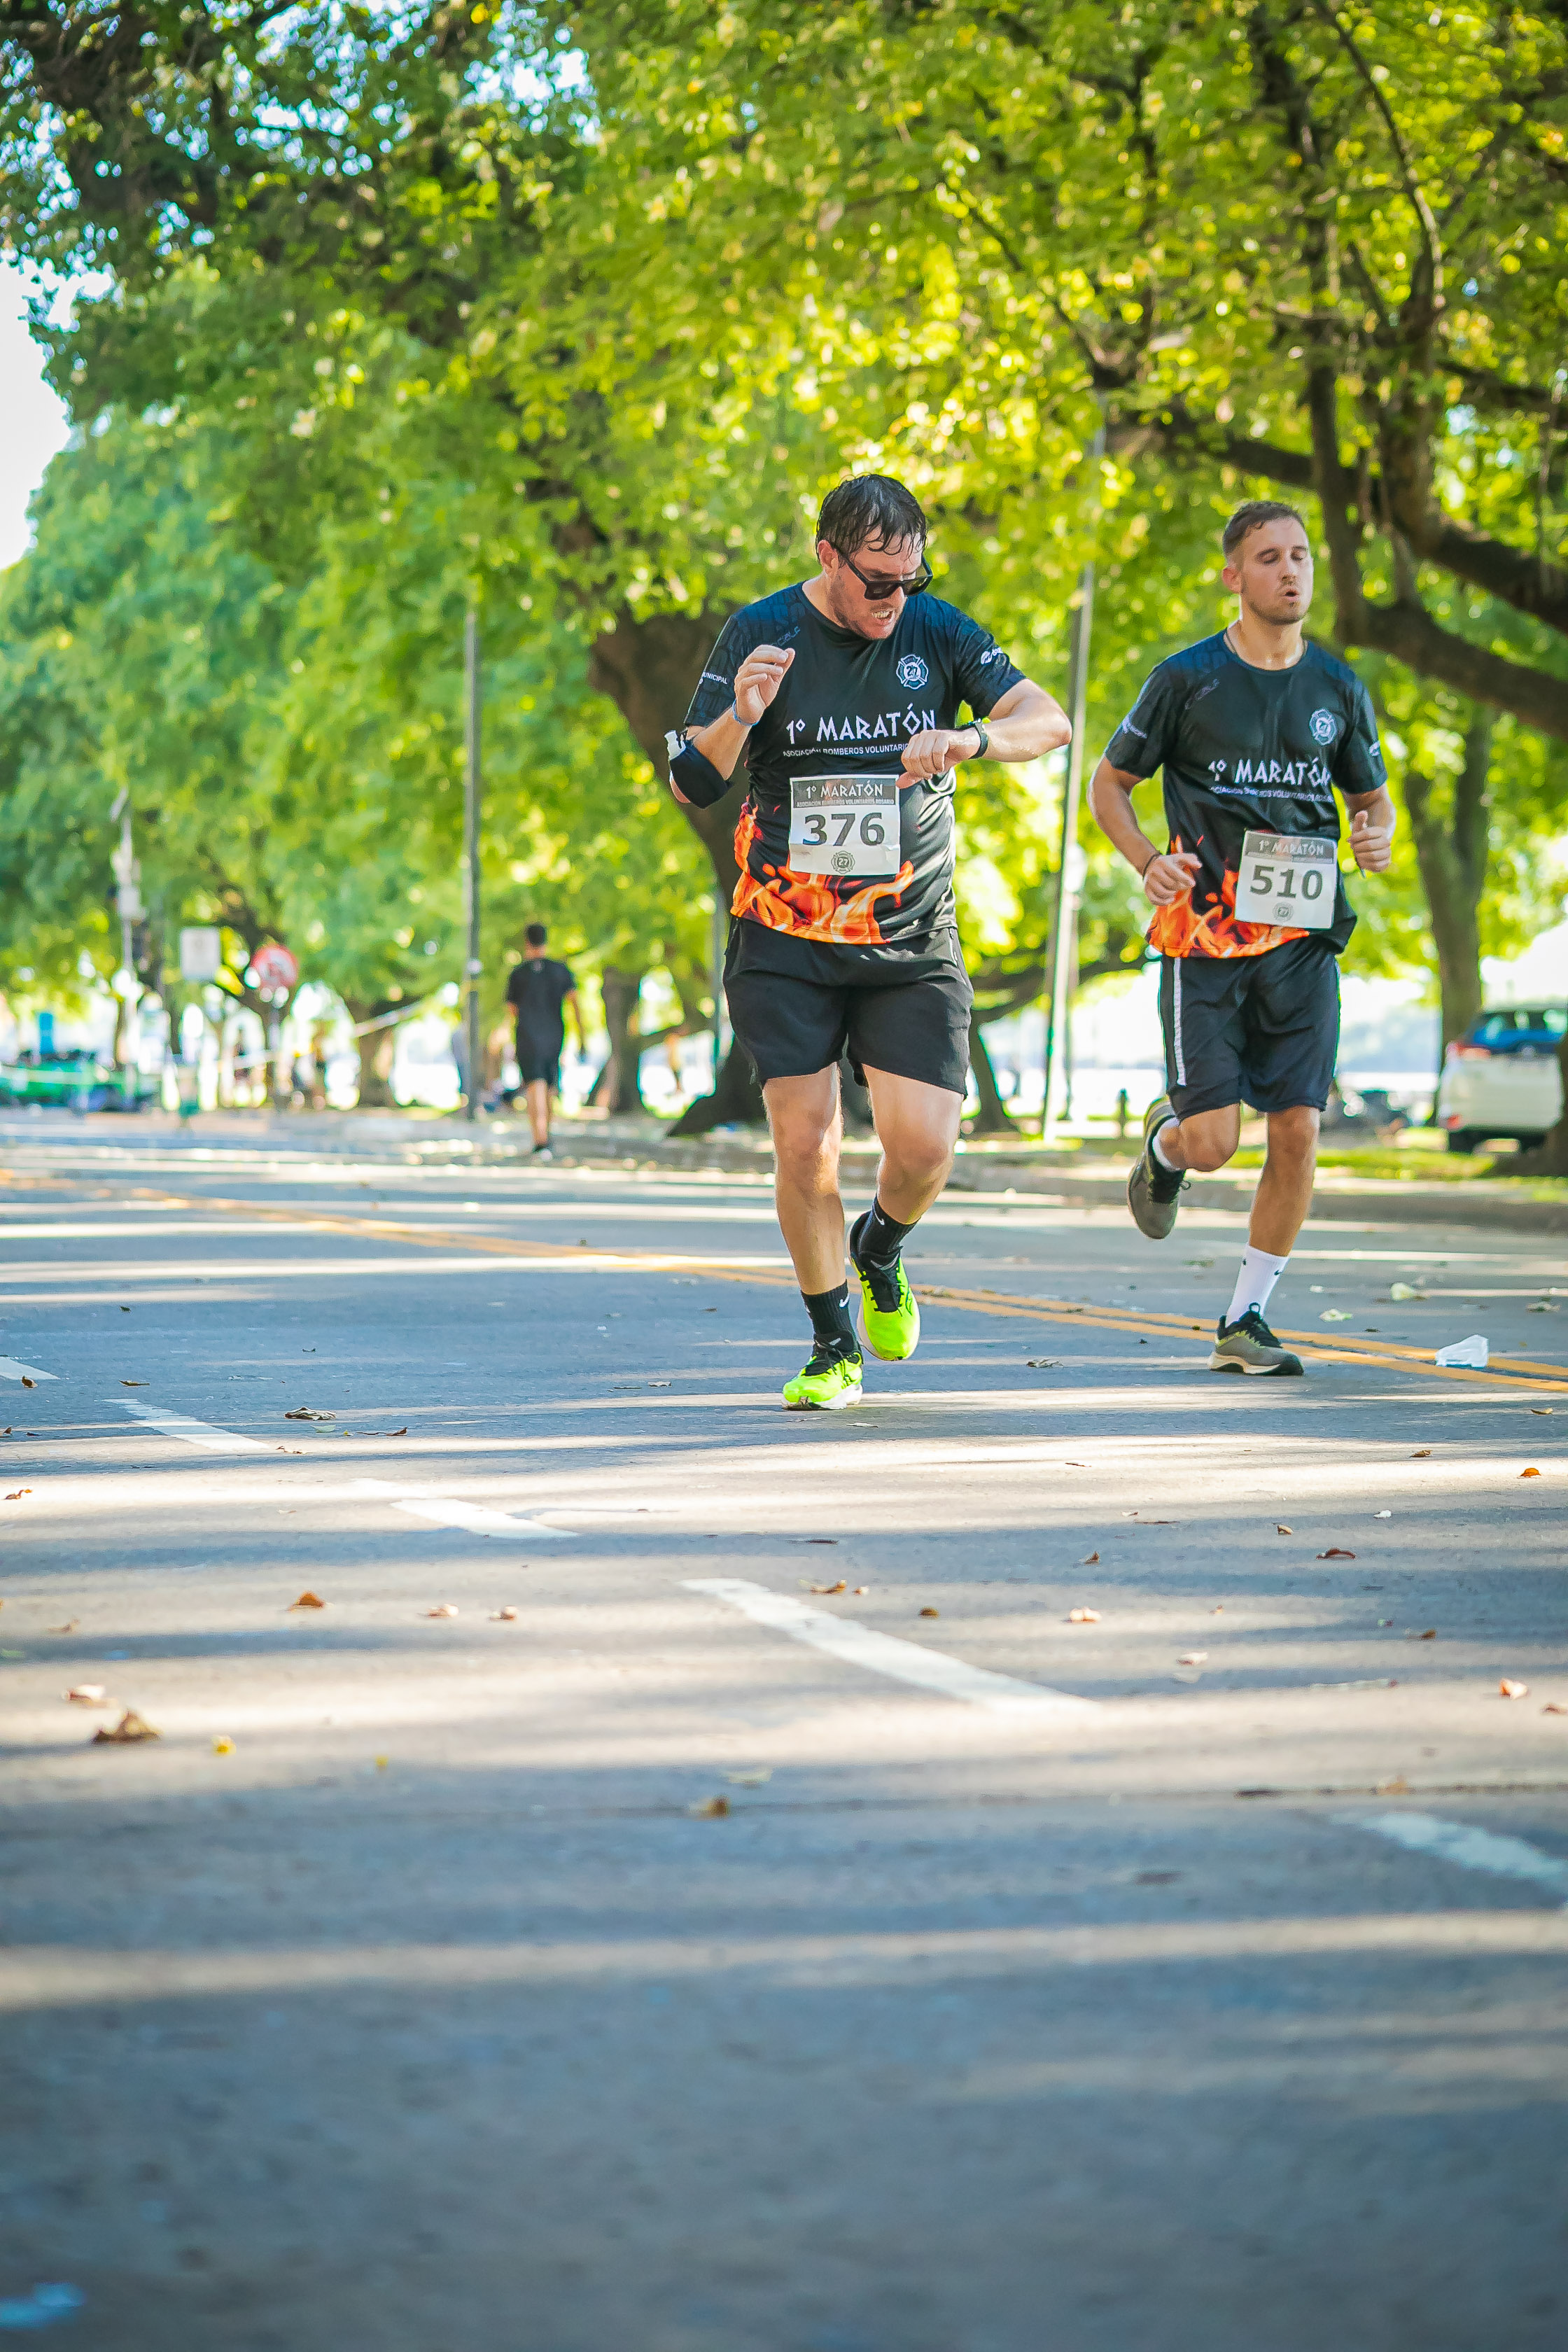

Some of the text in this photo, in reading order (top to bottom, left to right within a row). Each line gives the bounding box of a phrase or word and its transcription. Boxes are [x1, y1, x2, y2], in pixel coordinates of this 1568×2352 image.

[816, 702, 935, 742] MARATÓN
[822, 746, 864, 755] BOMBEROS
[1234, 756, 1331, 788] MARATÓN
[820, 780, 883, 798] MARATÓN
[802, 812, 885, 846] 376
[1270, 840, 1324, 856] MARATÓN
[1250, 864, 1323, 900] 510
